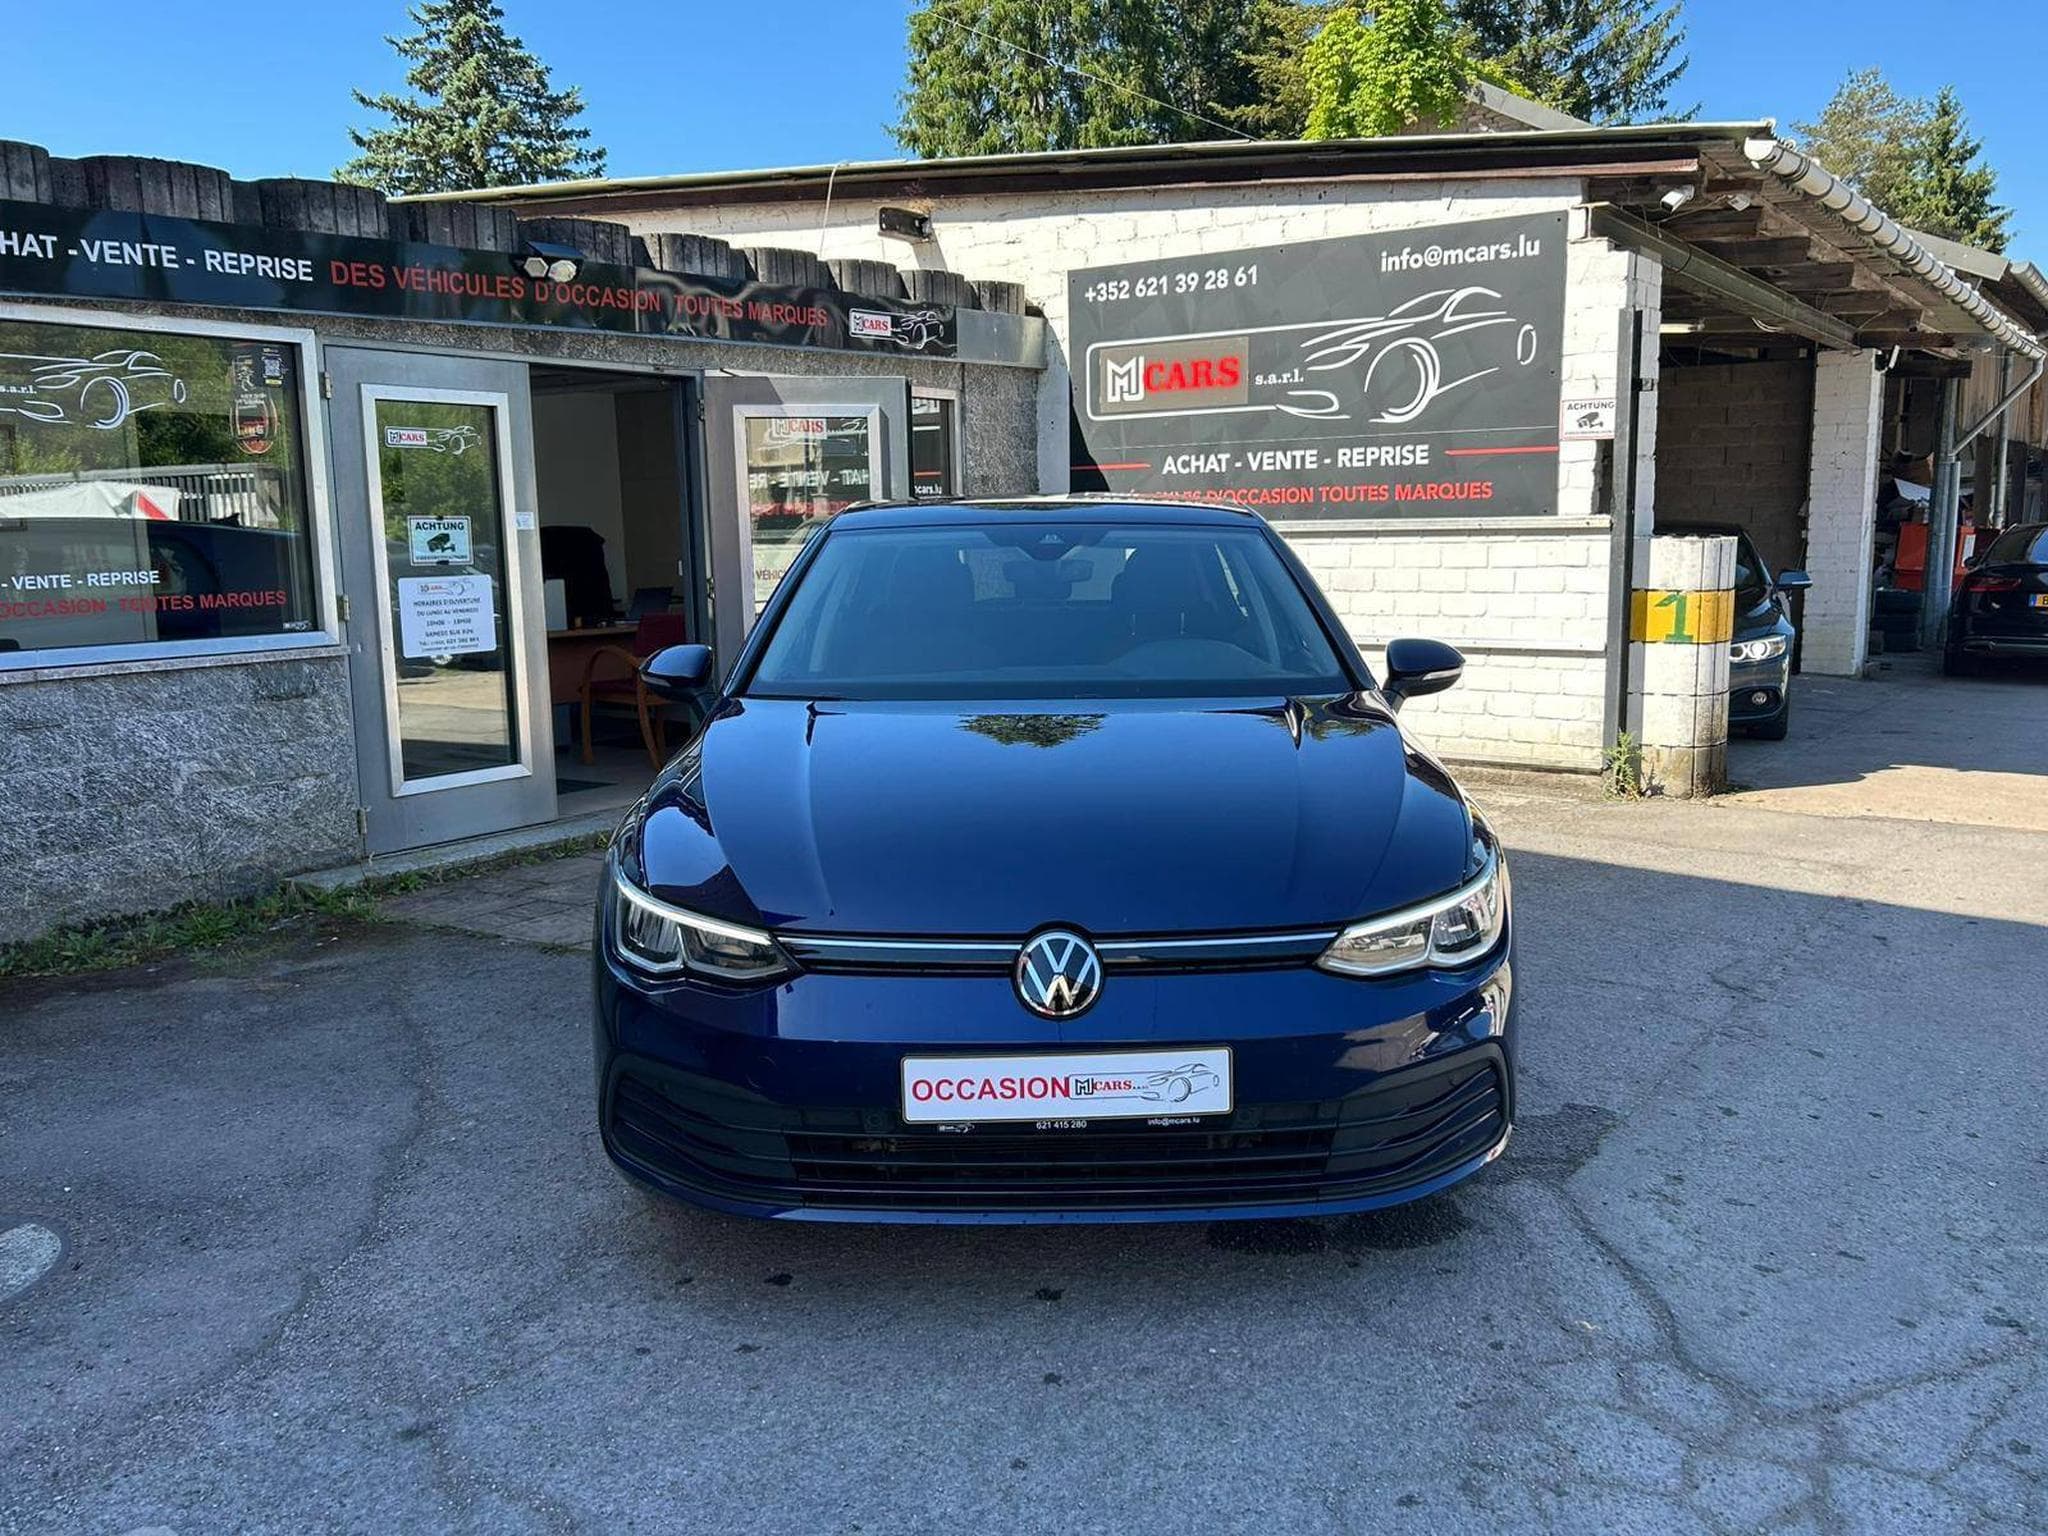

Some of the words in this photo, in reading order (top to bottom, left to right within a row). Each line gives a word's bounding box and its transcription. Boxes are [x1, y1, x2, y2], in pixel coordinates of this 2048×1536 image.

[1381, 234, 1540, 273] info@mcars.lu
[80, 239, 179, 269] VENTE
[204, 249, 313, 282] REPRISE
[330, 260, 386, 288] DES
[392, 262, 525, 299] VÉHICULES
[535, 281, 661, 312] D'OCCASION
[674, 295, 744, 319] TOUTES
[748, 301, 828, 327] MARQUES
[1084, 280, 1130, 302] +352
[1135, 275, 1168, 297] 621
[1175, 272, 1199, 293] 39
[1204, 269, 1229, 290] 28
[1234, 264, 1258, 287] 61
[1254, 368, 1304, 385] s.a.r.l.
[1567, 401, 1615, 411] ACHTUNG
[1162, 453, 1231, 475] ACHAT
[1247, 450, 1318, 471] VENTE
[1337, 445, 1430, 468] REPRISE
[1319, 485, 1389, 503] TOUTES
[1395, 481, 1493, 502] MARQUES
[415, 521, 465, 531] ACHTUNG
[11, 574, 72, 590] VENTE
[87, 570, 160, 587] REPRISE
[119, 595, 194, 613] TOUTES
[200, 590, 287, 609] MARQUES
[1654, 591, 1694, 644] 1
[912, 1076, 1070, 1101] OCCASION
[1036, 1121, 1051, 1130] 621
